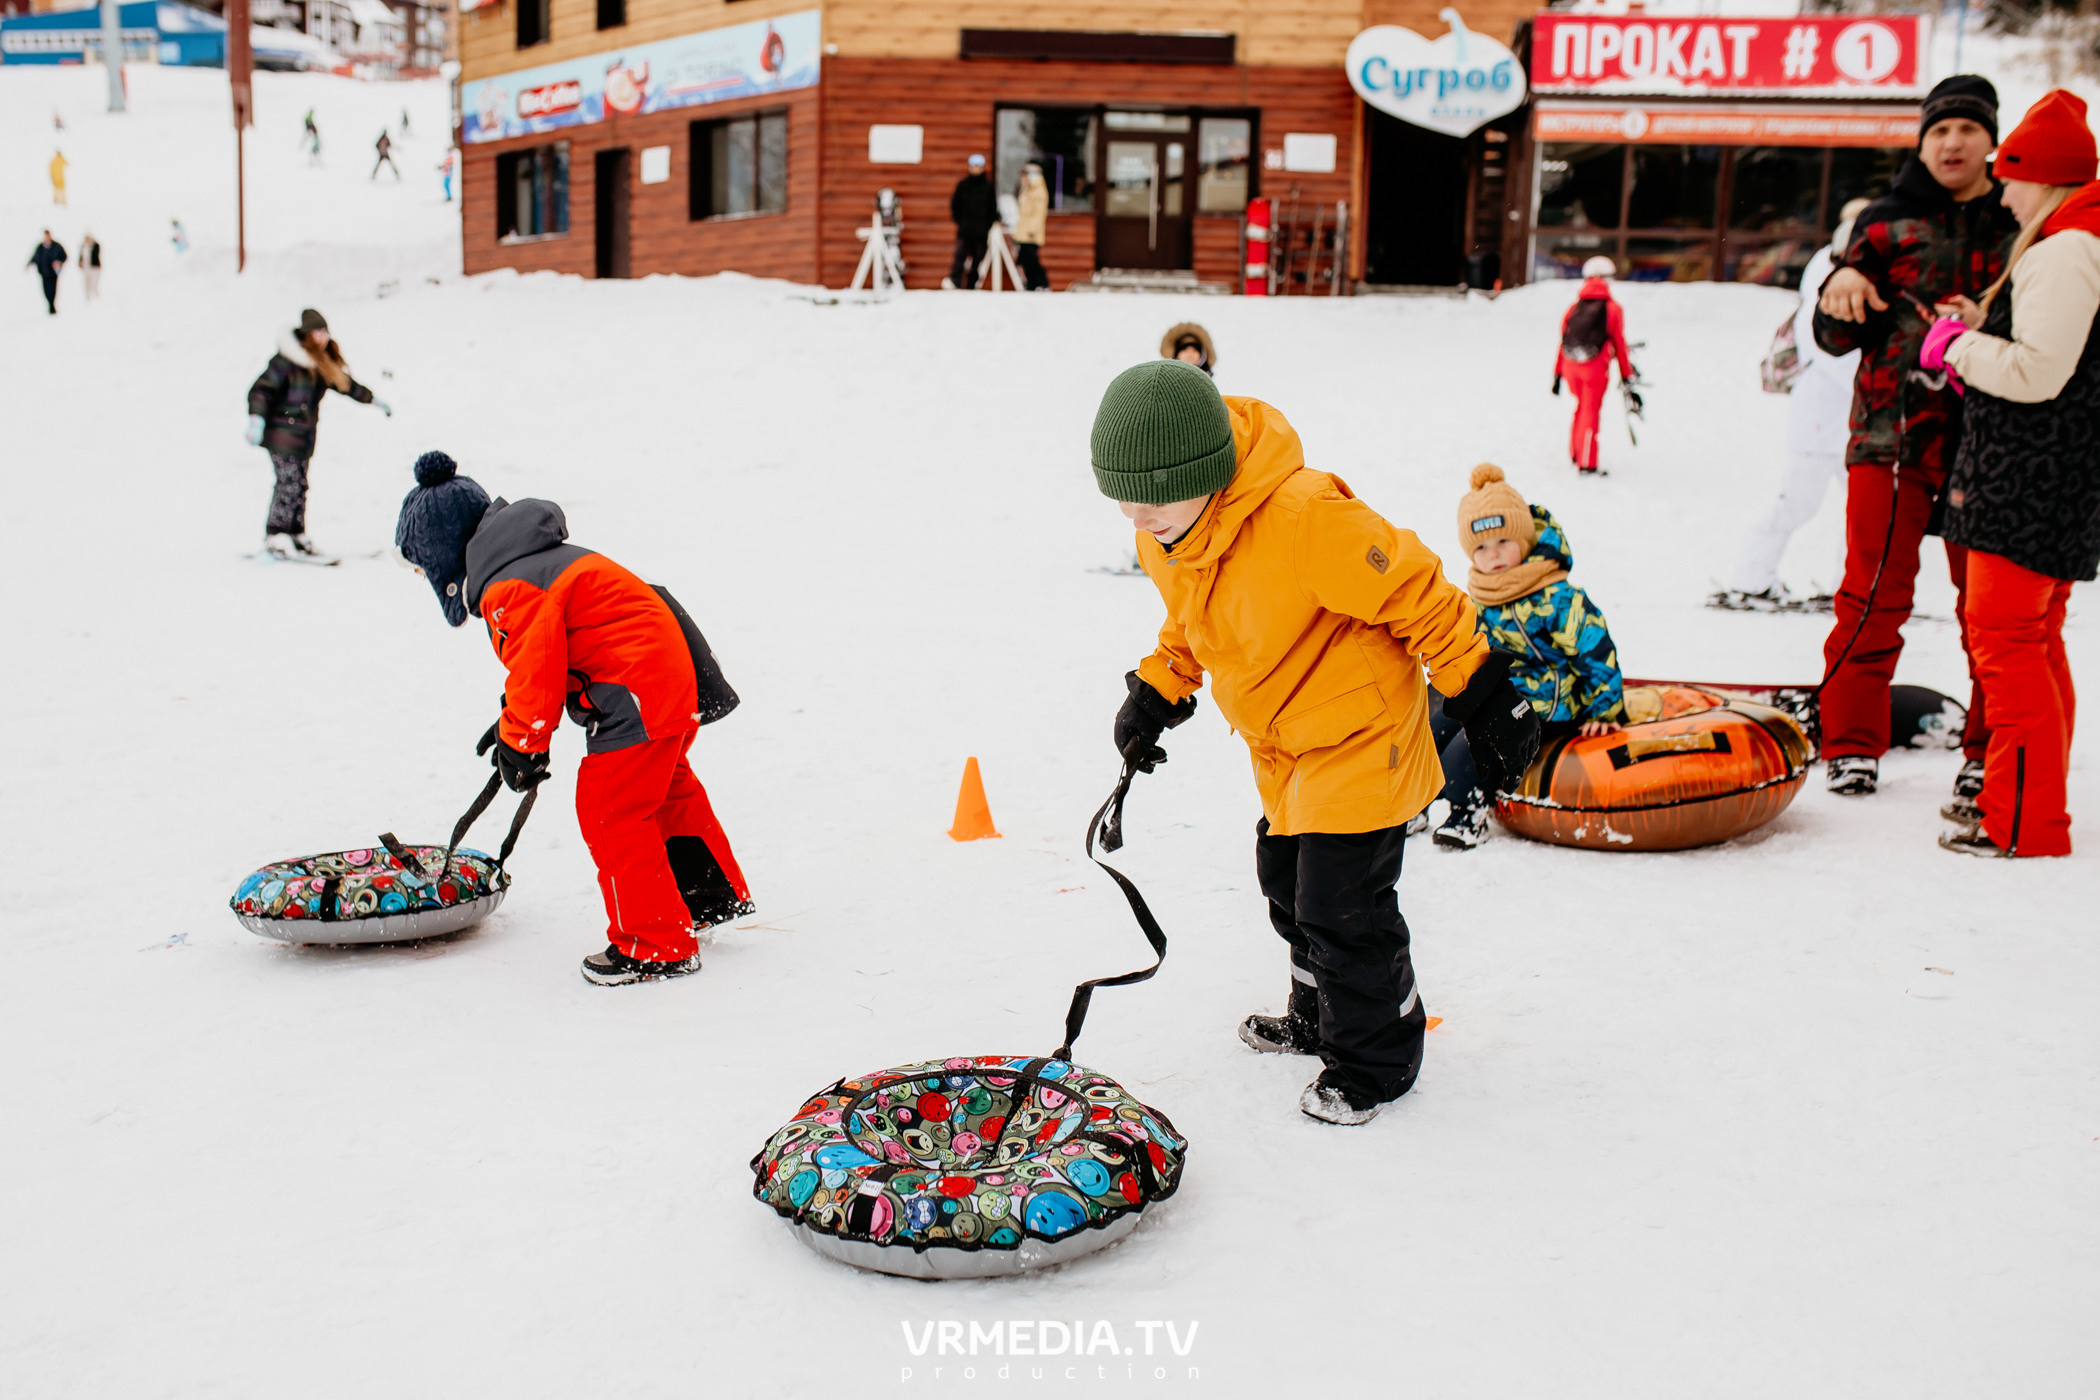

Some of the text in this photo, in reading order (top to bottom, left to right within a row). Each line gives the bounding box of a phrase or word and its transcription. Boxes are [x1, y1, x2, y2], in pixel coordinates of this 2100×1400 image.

[1551, 22, 1759, 79] ПРОКАТ
[1781, 25, 1822, 79] #
[1360, 56, 1513, 100] Сугроб
[1472, 516, 1502, 533] NEVER
